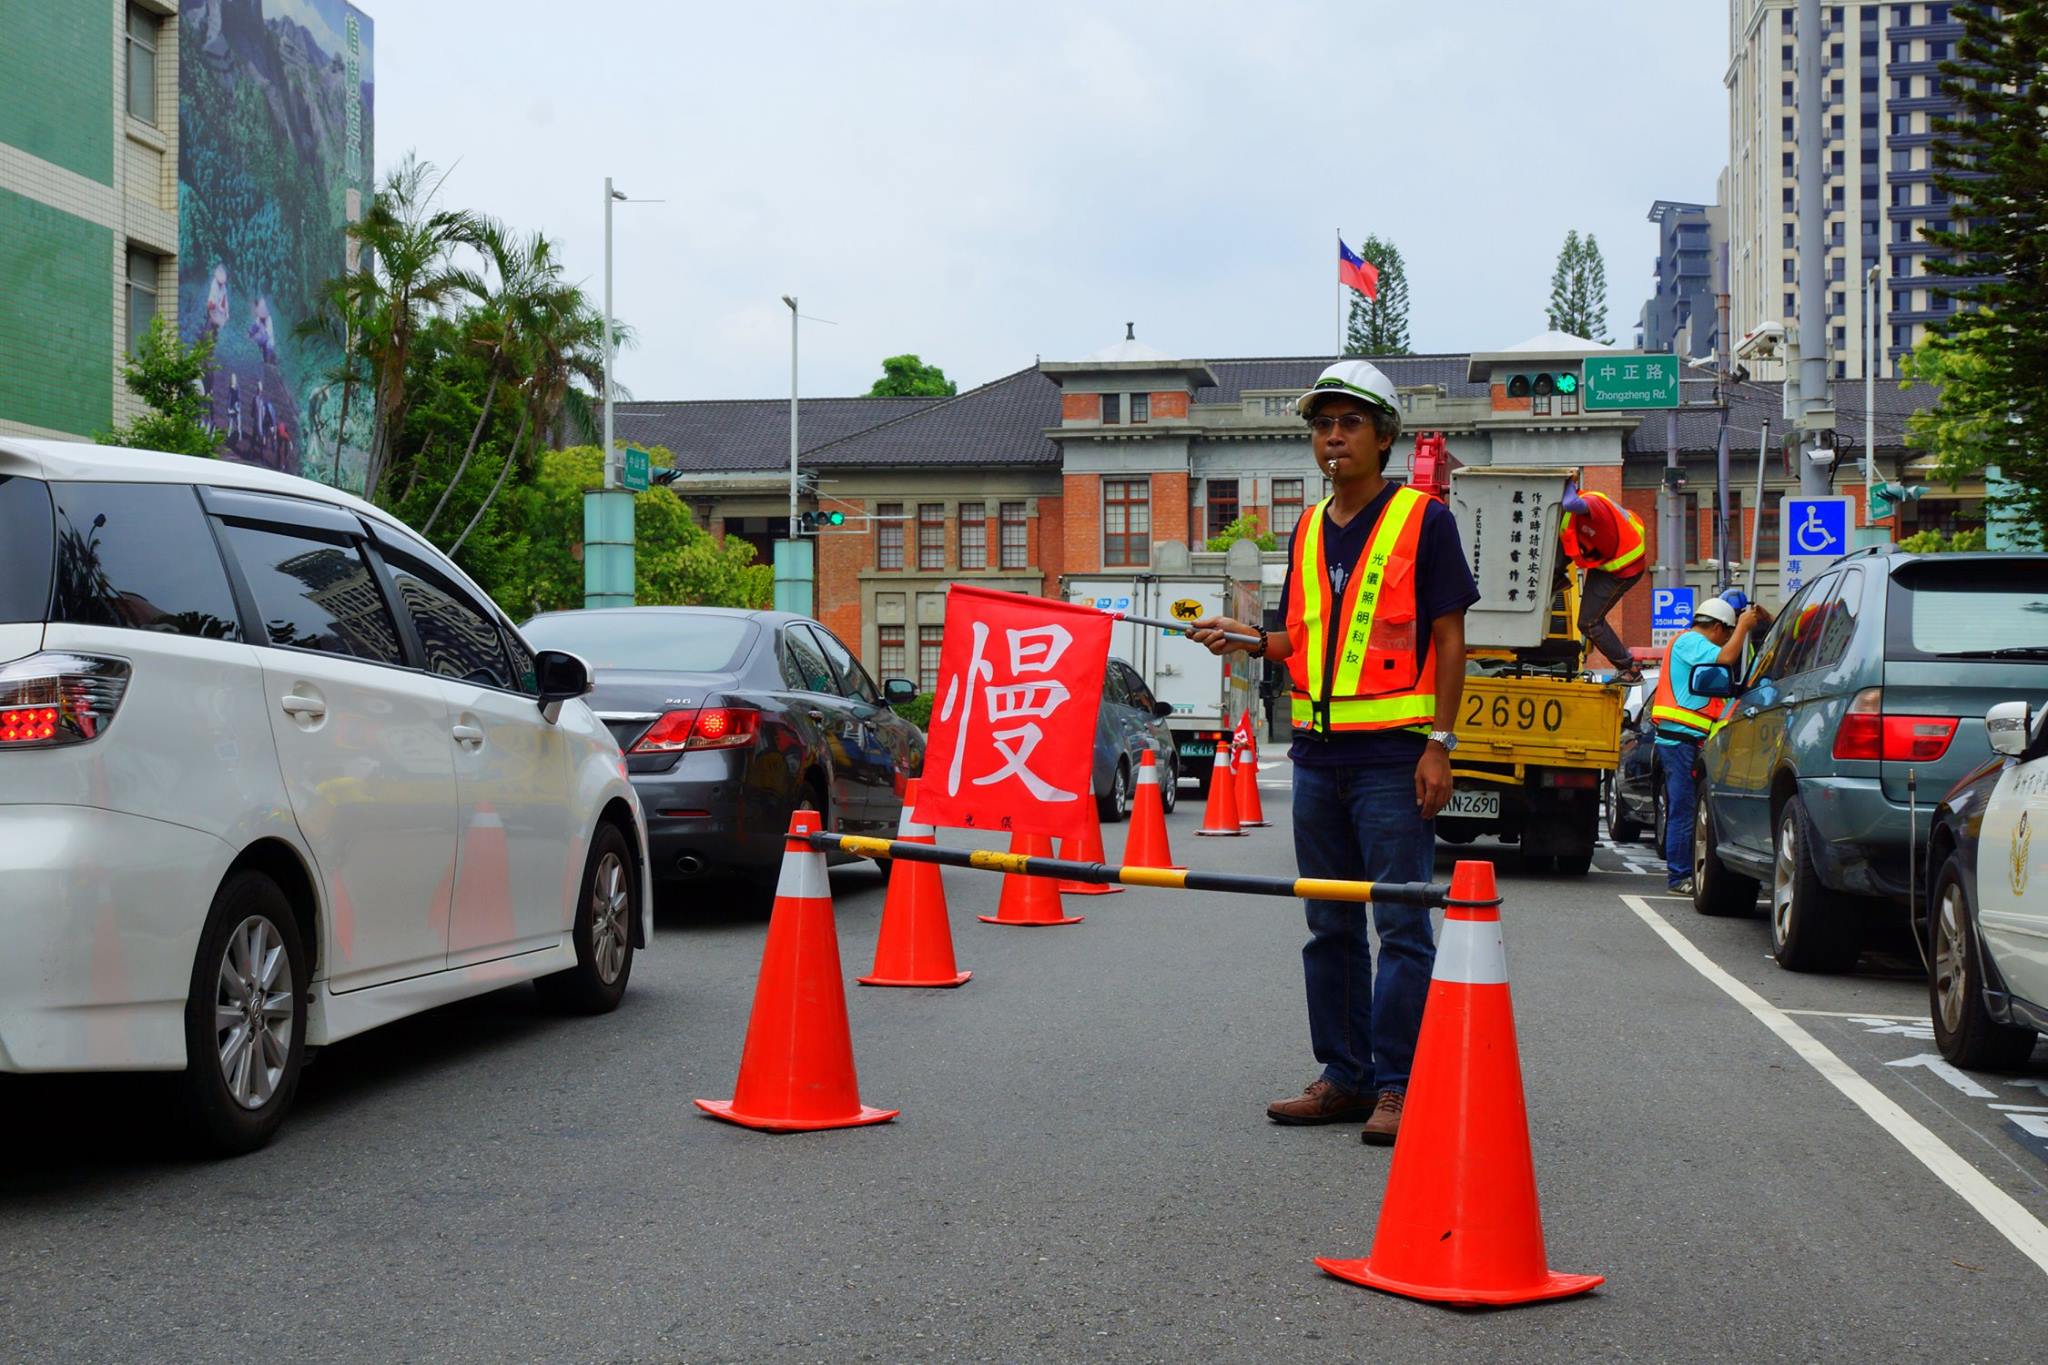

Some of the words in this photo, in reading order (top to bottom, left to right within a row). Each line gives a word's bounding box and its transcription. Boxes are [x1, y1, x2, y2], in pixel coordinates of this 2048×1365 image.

[1600, 363, 1664, 381] 中正路
[1595, 389, 1651, 402] Zhongzheng
[1652, 389, 1667, 399] Rd.
[1654, 590, 1674, 615] P
[940, 620, 1079, 803] 慢
[1465, 694, 1562, 732] 2690
